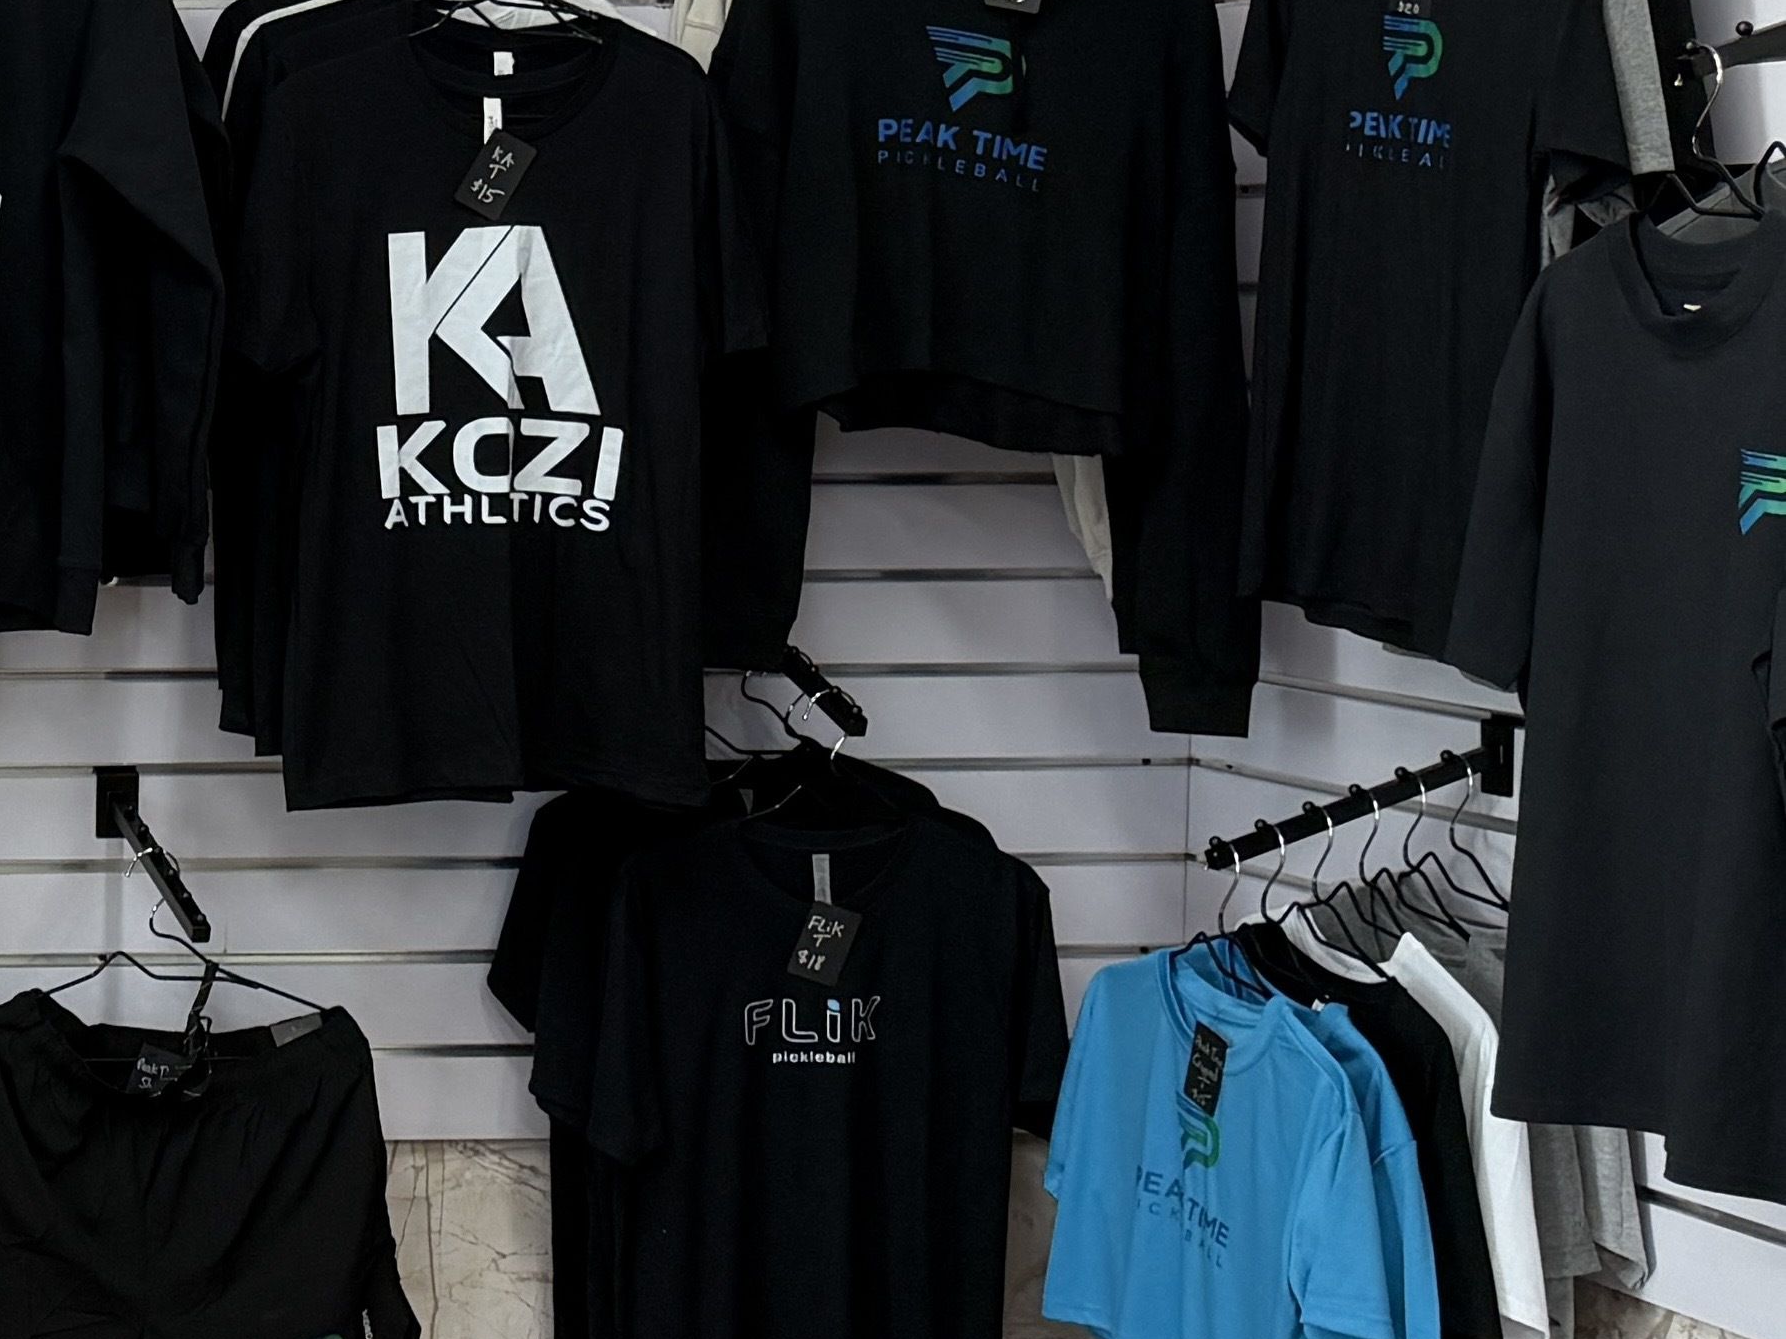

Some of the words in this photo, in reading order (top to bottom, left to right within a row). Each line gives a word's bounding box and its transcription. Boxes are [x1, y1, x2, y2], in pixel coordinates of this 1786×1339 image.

[878, 118, 959, 150] PEAK
[972, 129, 1047, 171] TIME
[492, 145, 514, 166] KA
[489, 163, 507, 180] T
[470, 179, 505, 203] $15
[388, 224, 602, 415] KA
[813, 934, 831, 947] T
[772, 1051, 856, 1064] pickleball
